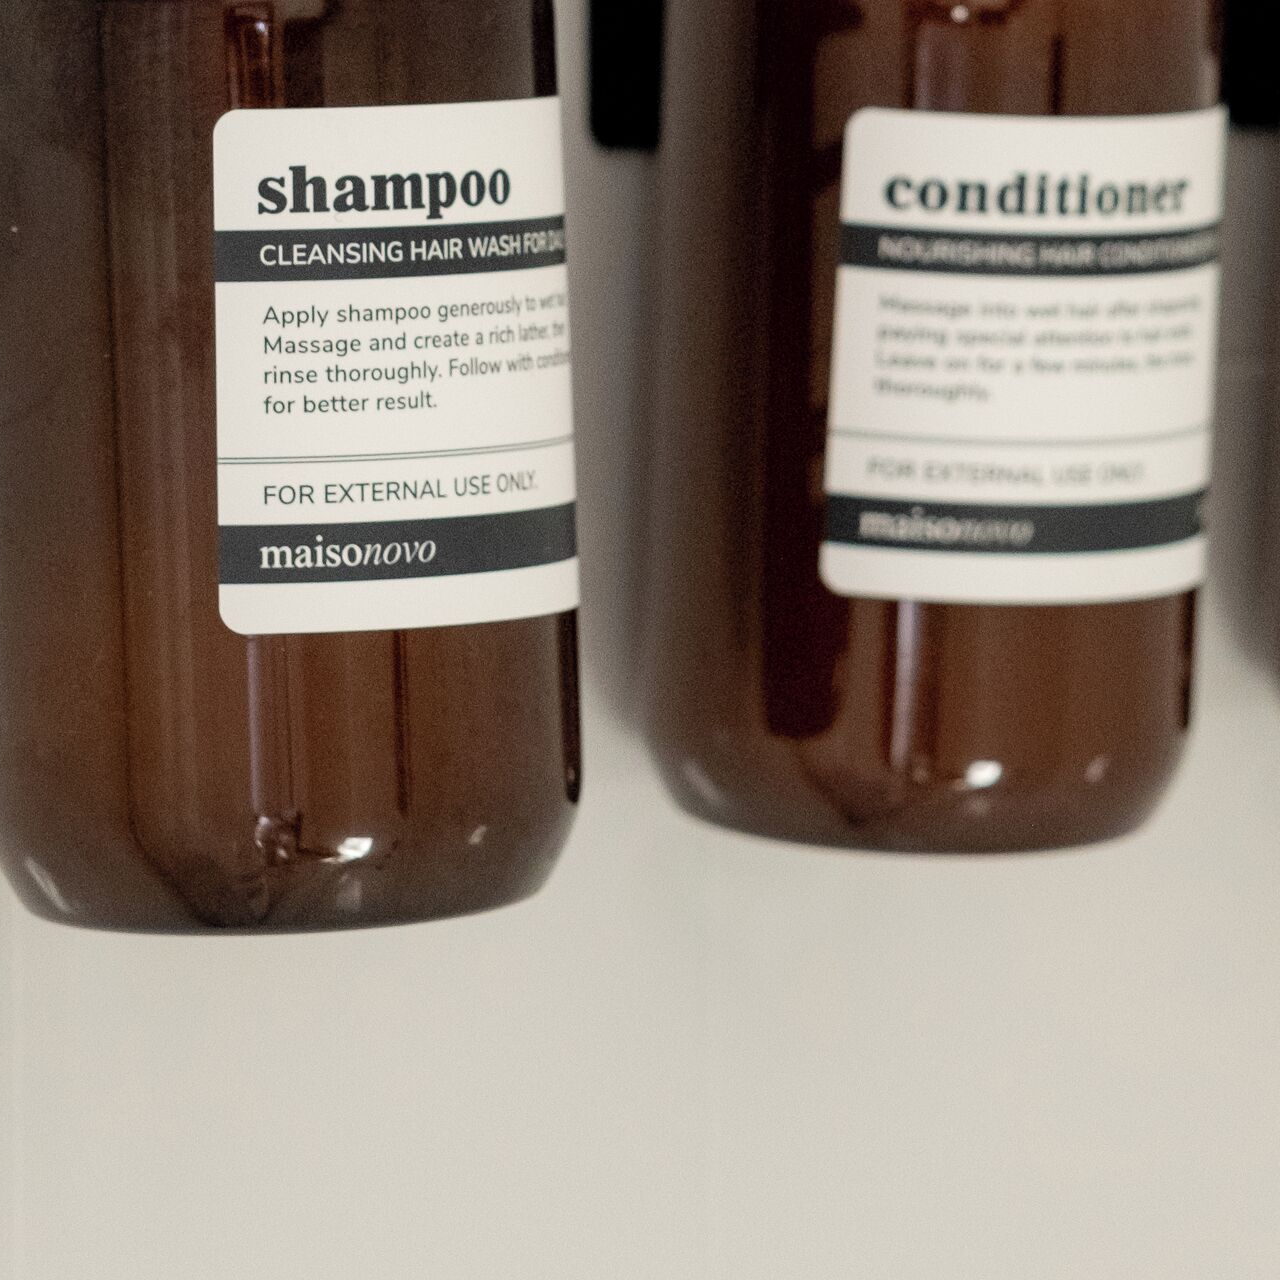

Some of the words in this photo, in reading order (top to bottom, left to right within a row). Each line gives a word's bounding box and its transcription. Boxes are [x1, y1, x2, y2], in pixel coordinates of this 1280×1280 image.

[258, 165, 511, 219] shampoo
[883, 171, 1189, 216] conditioner
[259, 240, 404, 266] CLEANSING
[410, 236, 463, 262] HAIR
[468, 234, 521, 259] WASH
[877, 234, 1036, 268] NOURISHING
[1037, 239, 1096, 269] HAIR
[263, 304, 329, 328] Apply
[337, 303, 431, 325] shampoo
[438, 295, 522, 323] generously
[264, 335, 361, 357] Massage
[369, 331, 407, 351] and
[414, 329, 469, 350] create
[475, 332, 484, 346] a
[489, 324, 514, 345] rich
[264, 365, 318, 384] rinse
[325, 359, 443, 384] thoroughly.
[449, 357, 502, 377] Follow
[506, 352, 535, 373] with
[263, 395, 296, 414] for
[303, 394, 368, 414] better
[376, 390, 437, 411] result.
[263, 484, 315, 505] FOR
[324, 478, 446, 504] EXTERNAL
[454, 473, 491, 497] USE
[496, 469, 538, 494] ONLY.
[866, 455, 917, 483] FOR
[921, 457, 1045, 487] EXTERNAL
[260, 534, 437, 570] maisonovo
